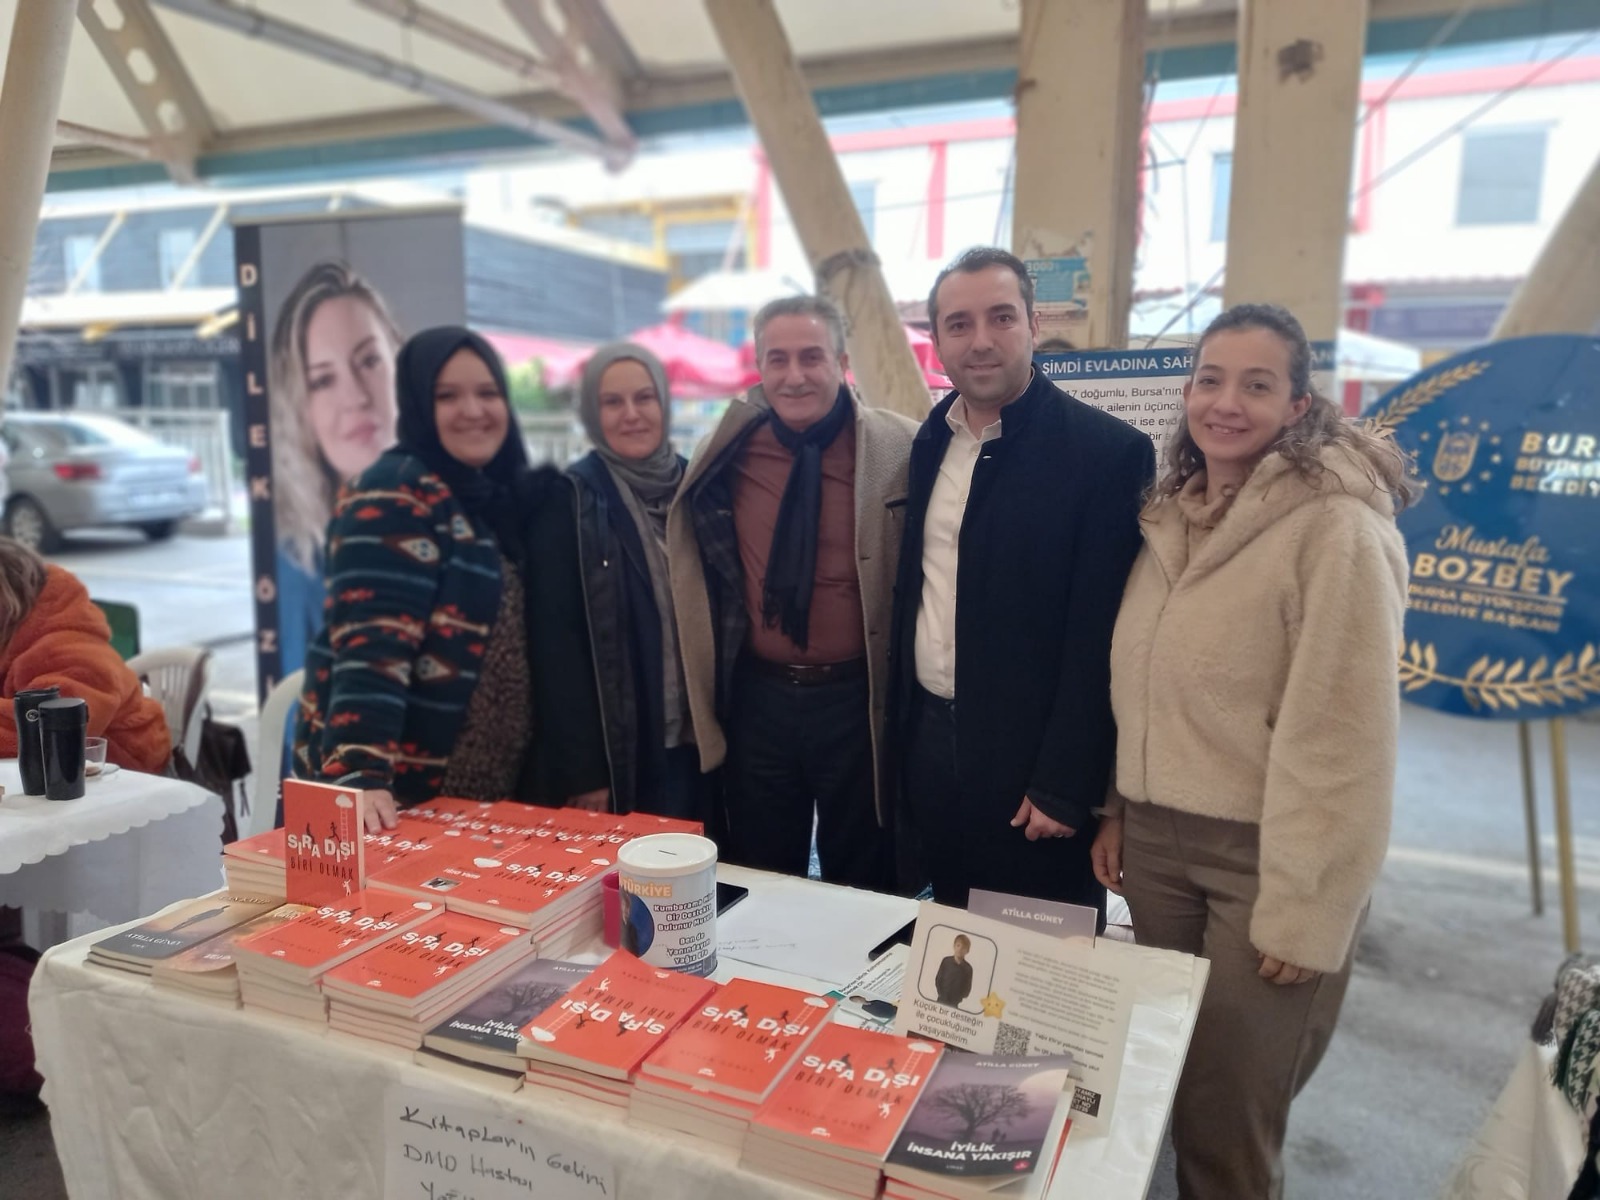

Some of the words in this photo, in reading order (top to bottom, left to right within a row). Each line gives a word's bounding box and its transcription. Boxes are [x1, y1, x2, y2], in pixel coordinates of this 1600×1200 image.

[1042, 358, 1081, 376] ŞİMDİ
[1085, 356, 1159, 373] EVLADINA
[1080, 388, 1128, 400] doğumlu,
[1106, 402, 1141, 412] ailenin
[1140, 417, 1155, 426] ise
[1520, 431, 1600, 459] BUR
[1434, 525, 1550, 568] Mustafa
[1412, 552, 1574, 597] BOZBEY
[287, 832, 322, 860] SIRA
[324, 838, 356, 863] DIŞI
[319, 861, 354, 881] OLMAK
[505, 862, 543, 879] SIRA
[545, 871, 588, 883] DIŞI
[620, 876, 672, 898] TÜRKİYE
[315, 906, 352, 926] SIRA
[354, 916, 399, 932] DIŞI
[657, 920, 693, 932] Bulunur
[666, 913, 681, 922] Bir
[1001, 907, 1032, 920] ATİLLA
[1033, 911, 1065, 926] GÜNEY
[401, 931, 441, 951] SIRA
[443, 942, 491, 958] DIŞI
[678, 936, 696, 946] Ben
[560, 998, 613, 1024] DIŞI
[701, 1005, 750, 1029] SIRA
[756, 1017, 810, 1038] DIŞI
[912, 998, 938, 1016] Küçük
[938, 1006, 950, 1019] bir
[950, 1010, 984, 1029] desteğin
[449, 1020, 492, 1035] İNSANA
[484, 1019, 518, 1033] İYİLİK
[617, 1010, 666, 1036] SIRA
[915, 1010, 926, 1021] ile
[926, 1014, 977, 1037] çocukluğumu
[918, 1022, 968, 1046] yaşayabilirim
[802, 1055, 856, 1082] SIRA
[863, 1067, 921, 1089] DIŞI
[1009, 1060, 1041, 1069] GÜNEY
[906, 1141, 967, 1162] İNSANA
[970, 1150, 1033, 1164] YAKIŞIR
[950, 1140, 995, 1152] İYİLİK
[403, 1143, 458, 1173] DMD
